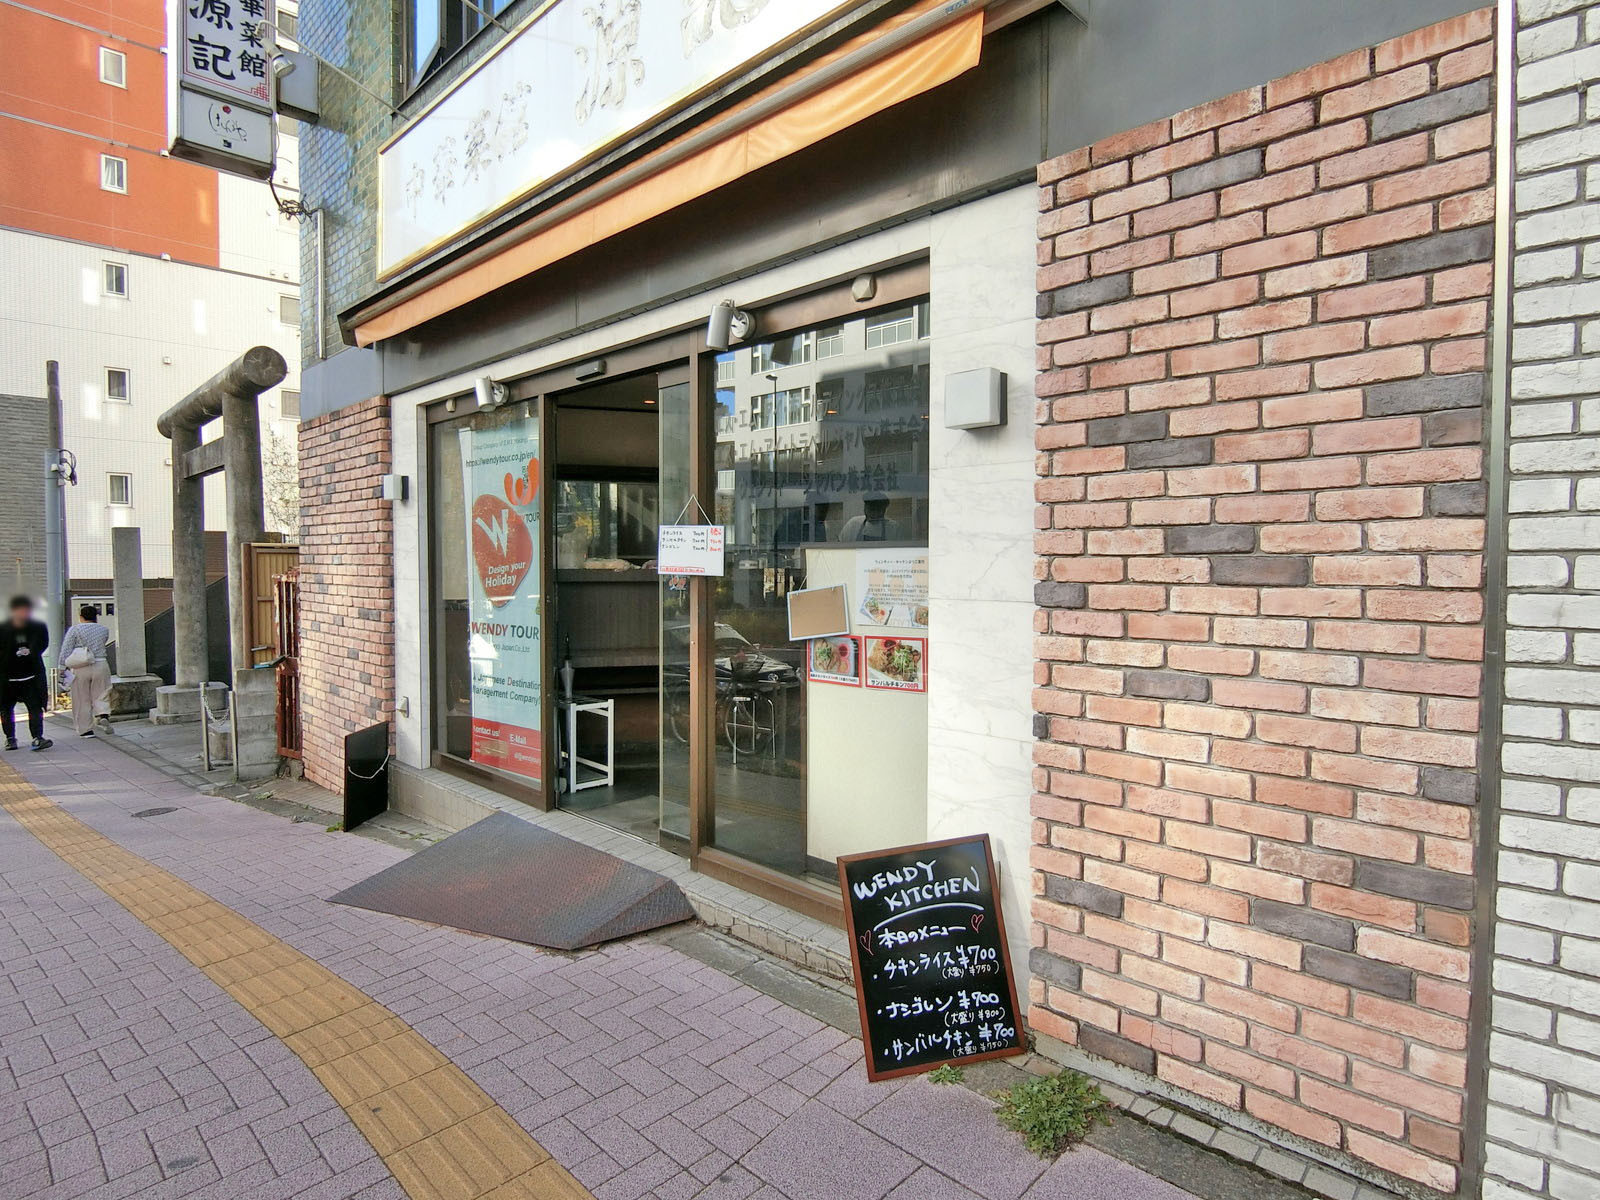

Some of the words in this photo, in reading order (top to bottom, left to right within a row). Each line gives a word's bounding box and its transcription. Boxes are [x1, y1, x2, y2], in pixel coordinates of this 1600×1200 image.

[488, 564, 510, 575] Design
[511, 562, 526, 573] your
[485, 574, 517, 588] Holiday
[471, 621, 509, 637] WENDY
[510, 624, 540, 640] TOUR
[477, 673, 506, 685] Jnese
[853, 859, 937, 900] WENDY
[884, 866, 981, 912] KITCHEN
[878, 925, 967, 949] 本日のメニュー
